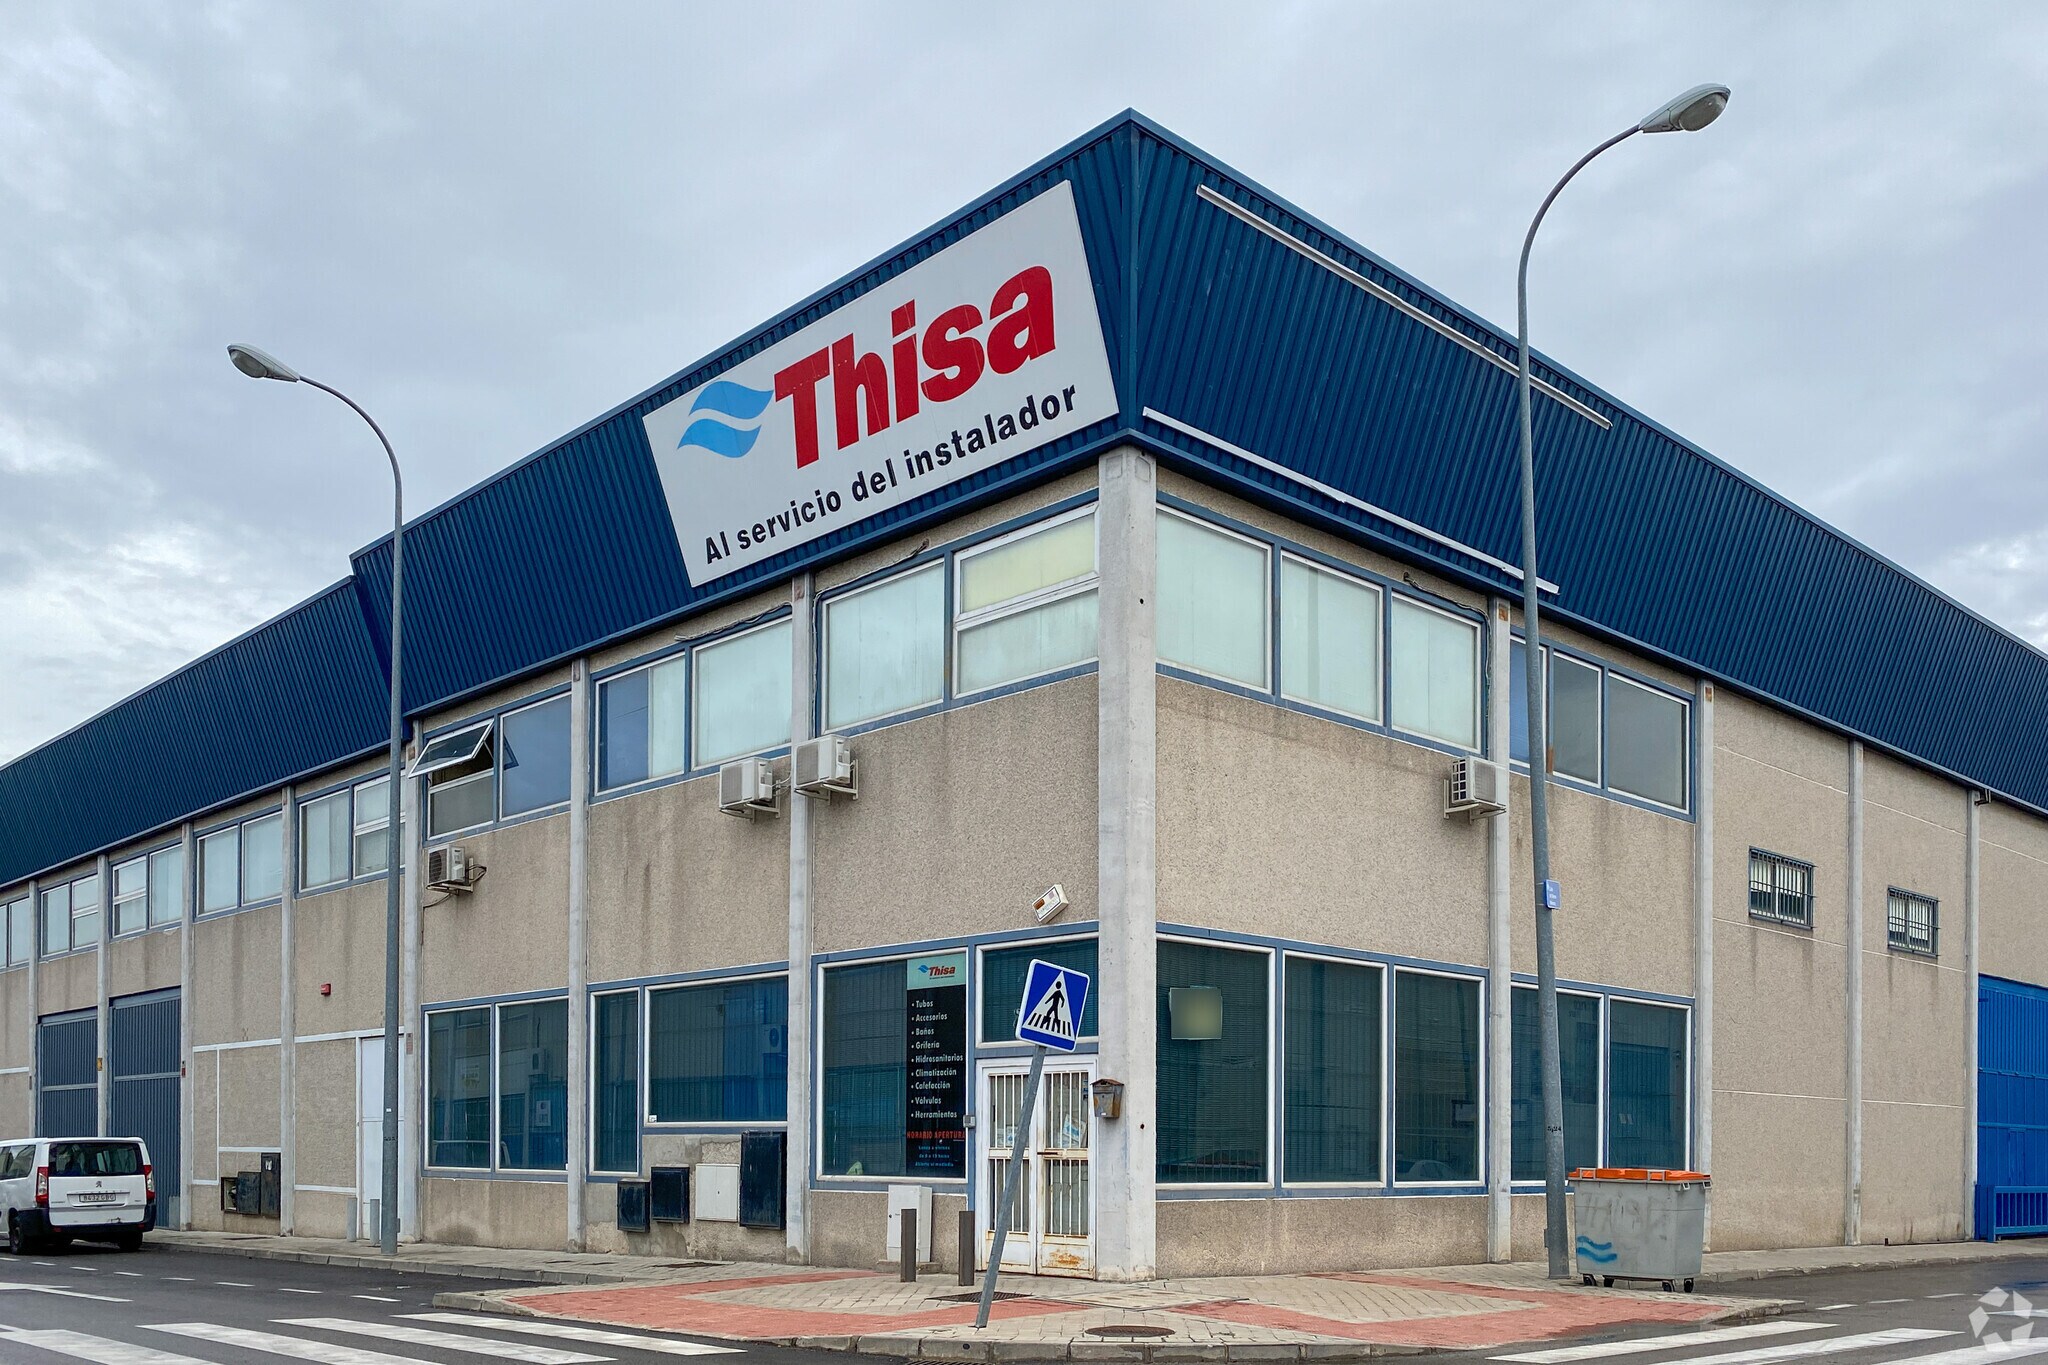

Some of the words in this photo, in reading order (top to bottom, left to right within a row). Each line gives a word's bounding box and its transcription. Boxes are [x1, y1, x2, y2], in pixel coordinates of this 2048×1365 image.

[774, 265, 1056, 469] Thisa
[705, 531, 731, 565] Al
[737, 489, 842, 551] servicio
[851, 458, 898, 502] del
[903, 384, 1076, 480] instalador
[929, 966, 956, 977] Thisa
[916, 1000, 933, 1008] Tubos
[915, 1012, 948, 1022] Accesorios
[915, 1067, 957, 1077] Climatización
[915, 1081, 951, 1090] Calefacción
[914, 1110, 957, 1119] Herramientas
[907, 1131, 932, 1139] HORARIO
[934, 1130, 965, 1139] APERTURA
